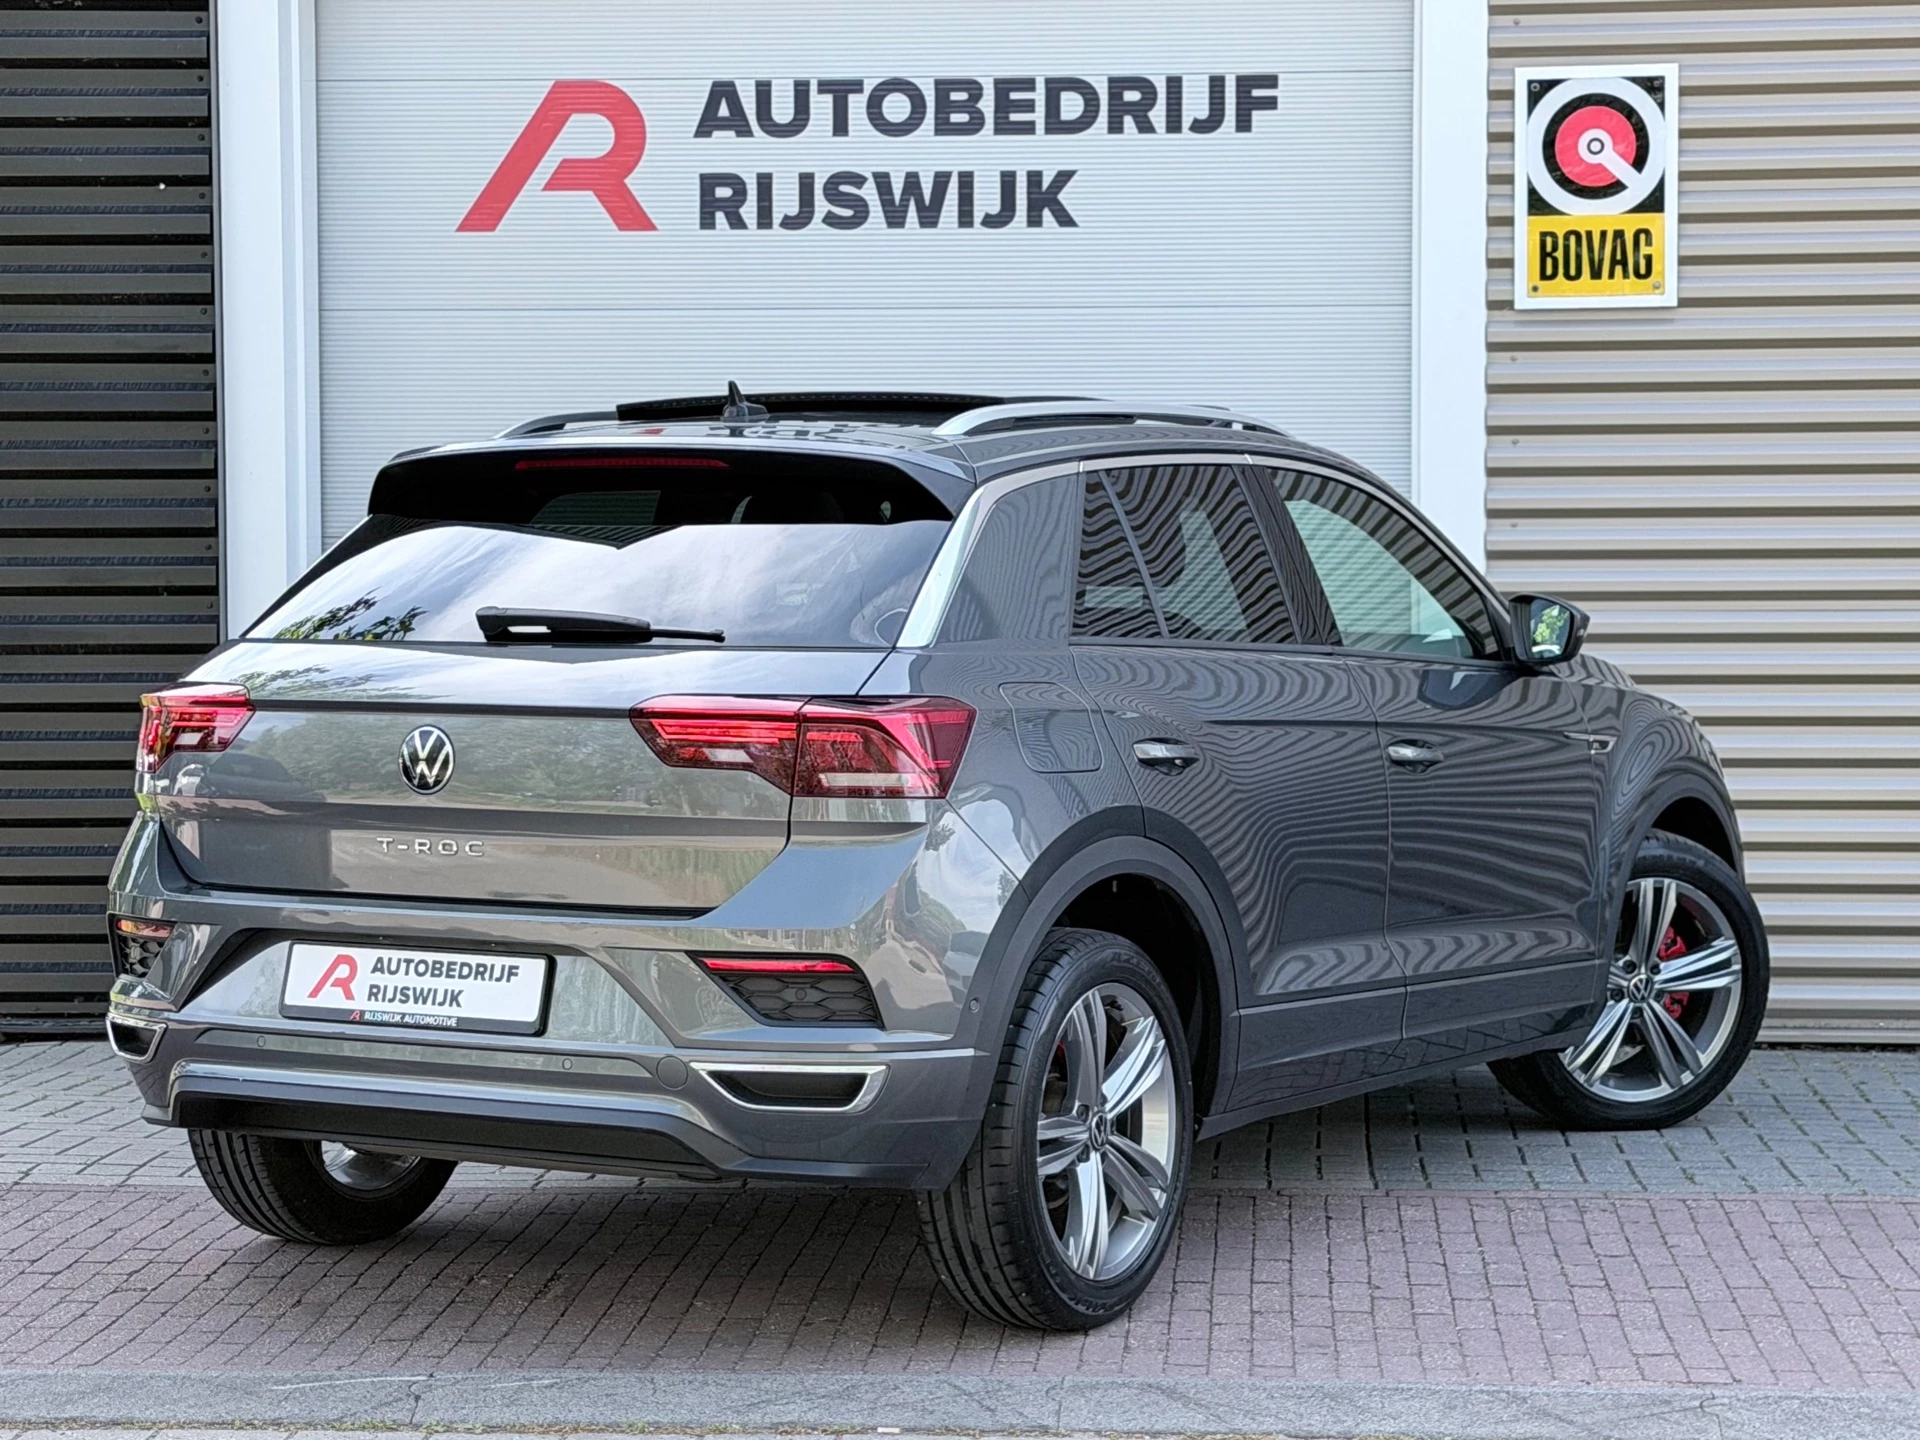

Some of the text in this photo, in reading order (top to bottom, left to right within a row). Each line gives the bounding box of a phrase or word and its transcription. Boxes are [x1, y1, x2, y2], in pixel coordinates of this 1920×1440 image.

[693, 74, 1280, 139] AUTOBEDRIJF
[698, 169, 1080, 231] RIJSWIJK
[1539, 228, 1653, 282] BOVAG
[376, 837, 486, 857] T-ROC
[370, 956, 520, 983] AUTOBEDRIJF
[367, 984, 465, 1009] RIJSWIJK
[364, 1011, 403, 1023] RIJSWIJK
[404, 1014, 458, 1027] AUTOMOTIVE
